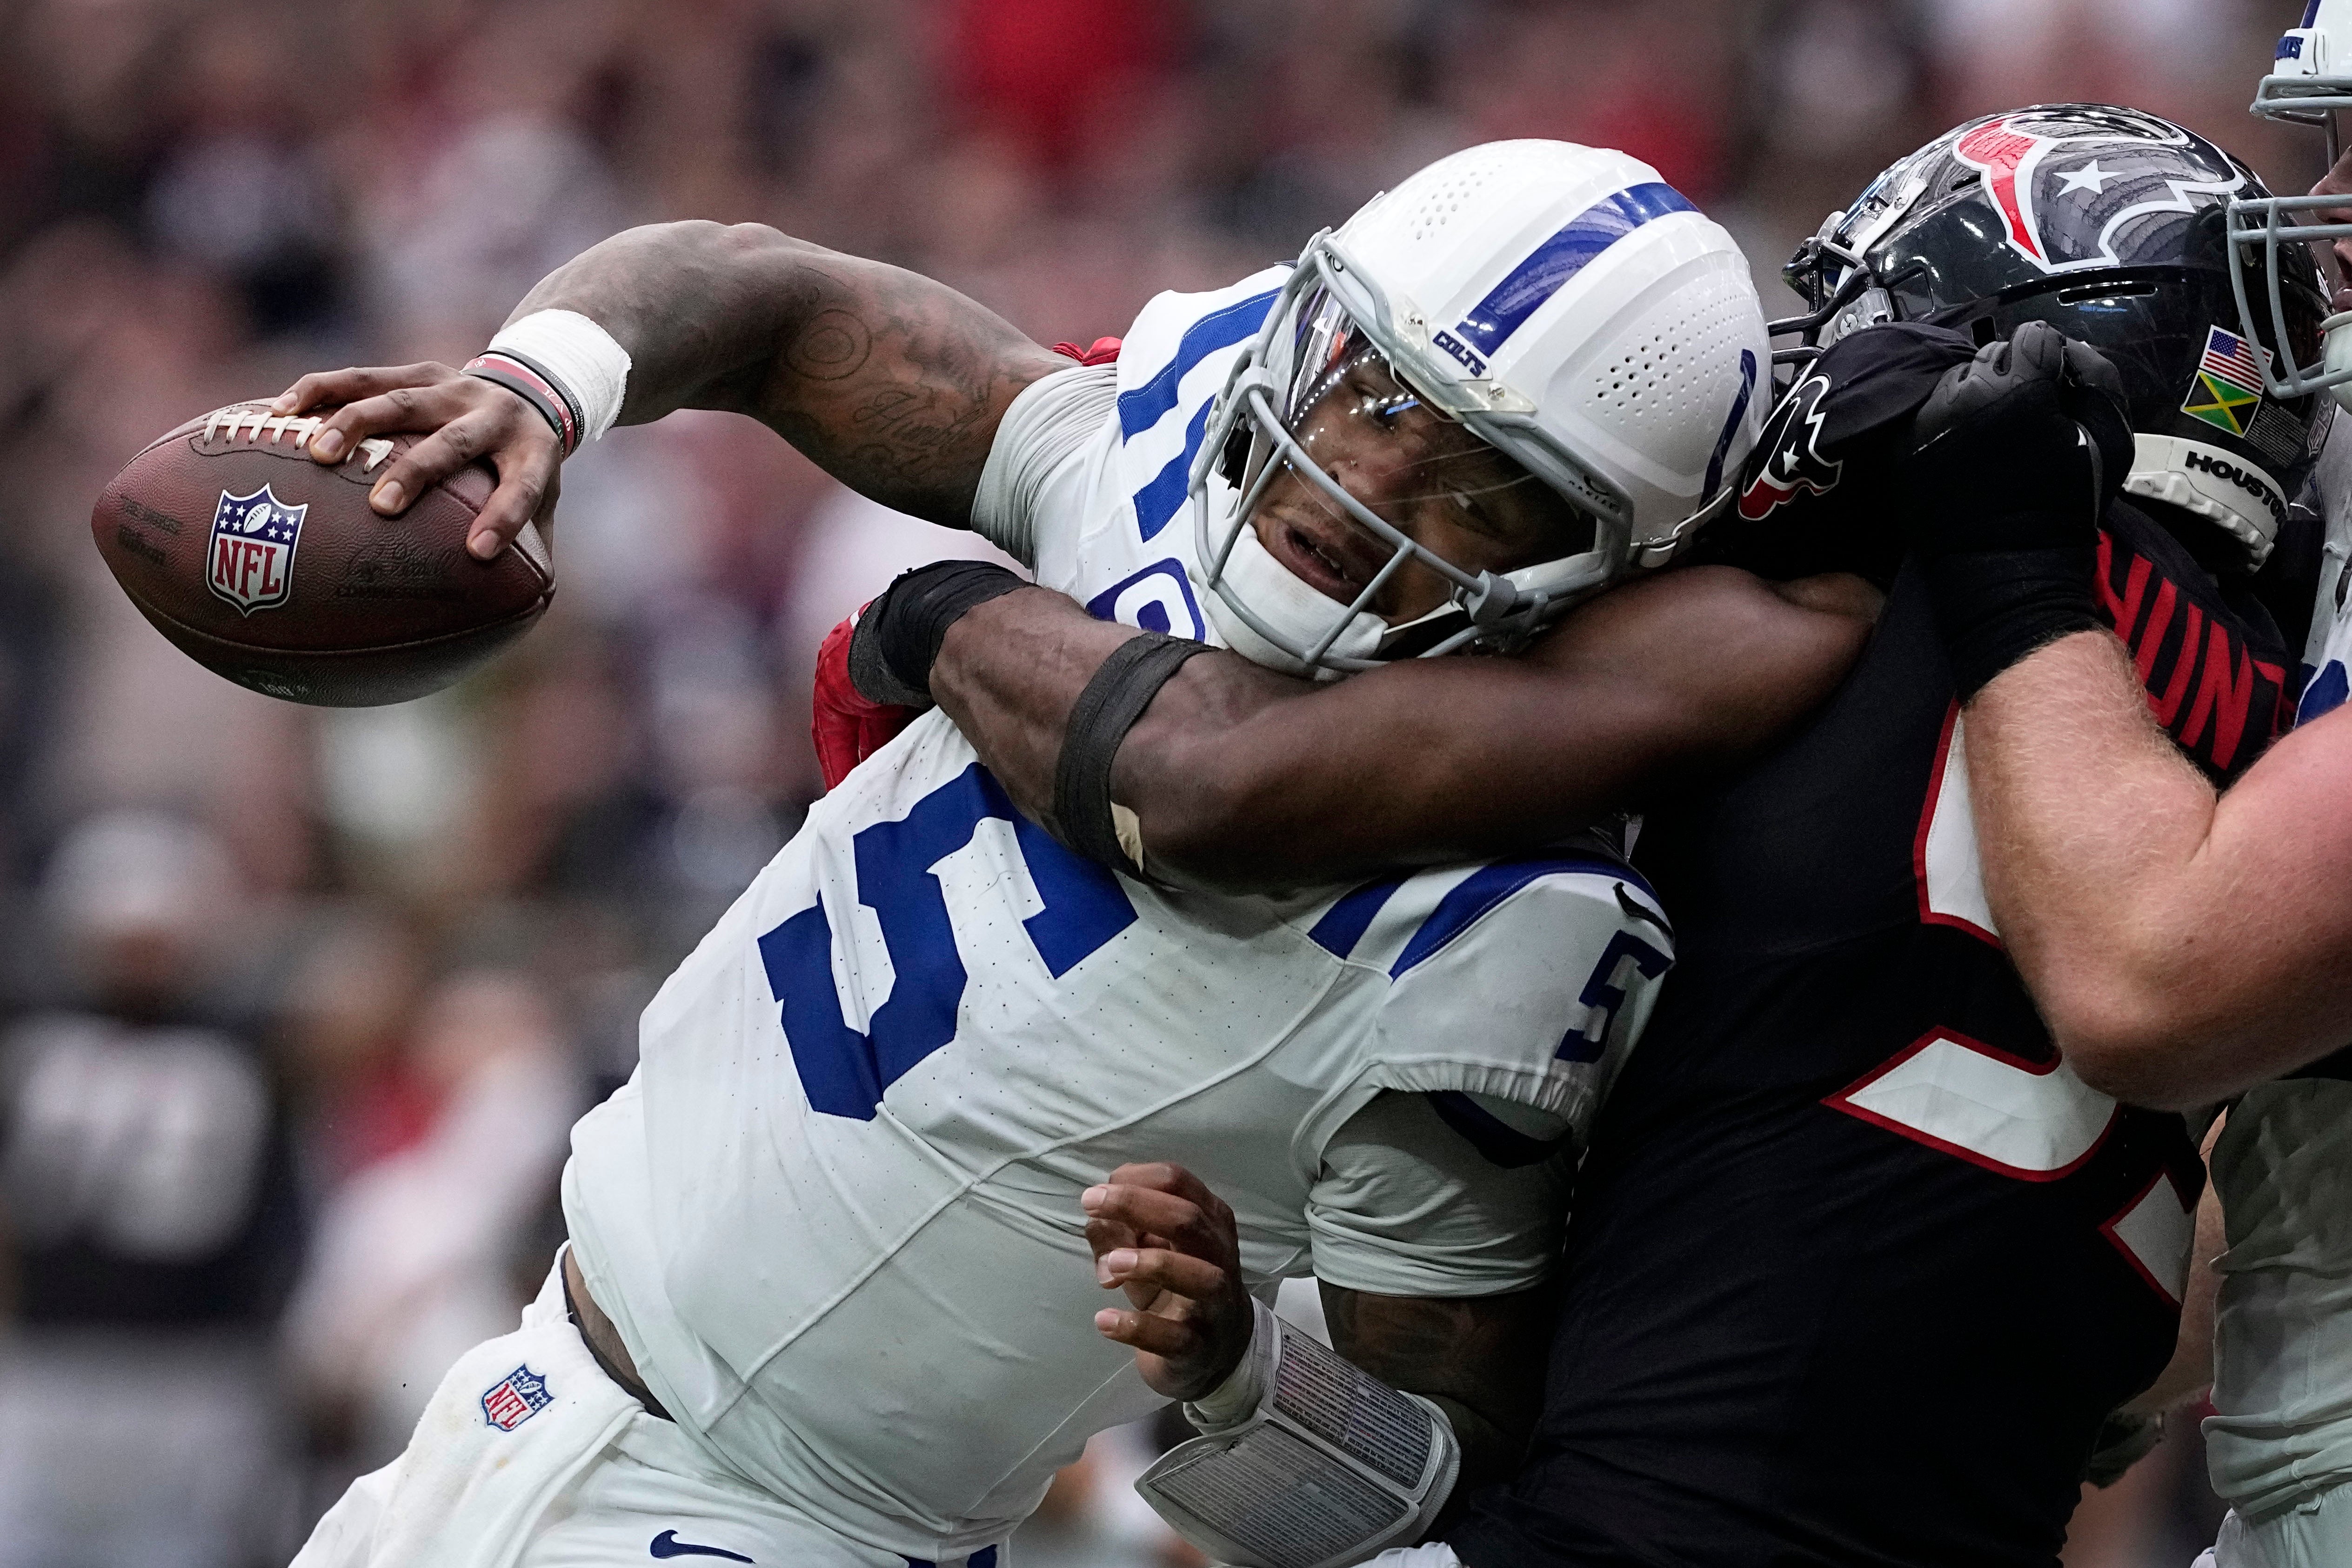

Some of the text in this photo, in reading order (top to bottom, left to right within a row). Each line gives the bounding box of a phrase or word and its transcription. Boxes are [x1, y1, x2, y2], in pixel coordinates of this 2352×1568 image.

[1432, 330, 1487, 378] COLTS
[2185, 450, 2288, 529] HOUSTO
[214, 538, 281, 600] NFL
[756, 761, 1140, 1122] 5
[1553, 929, 1675, 1064] 5
[485, 1382, 528, 1429] NFL
